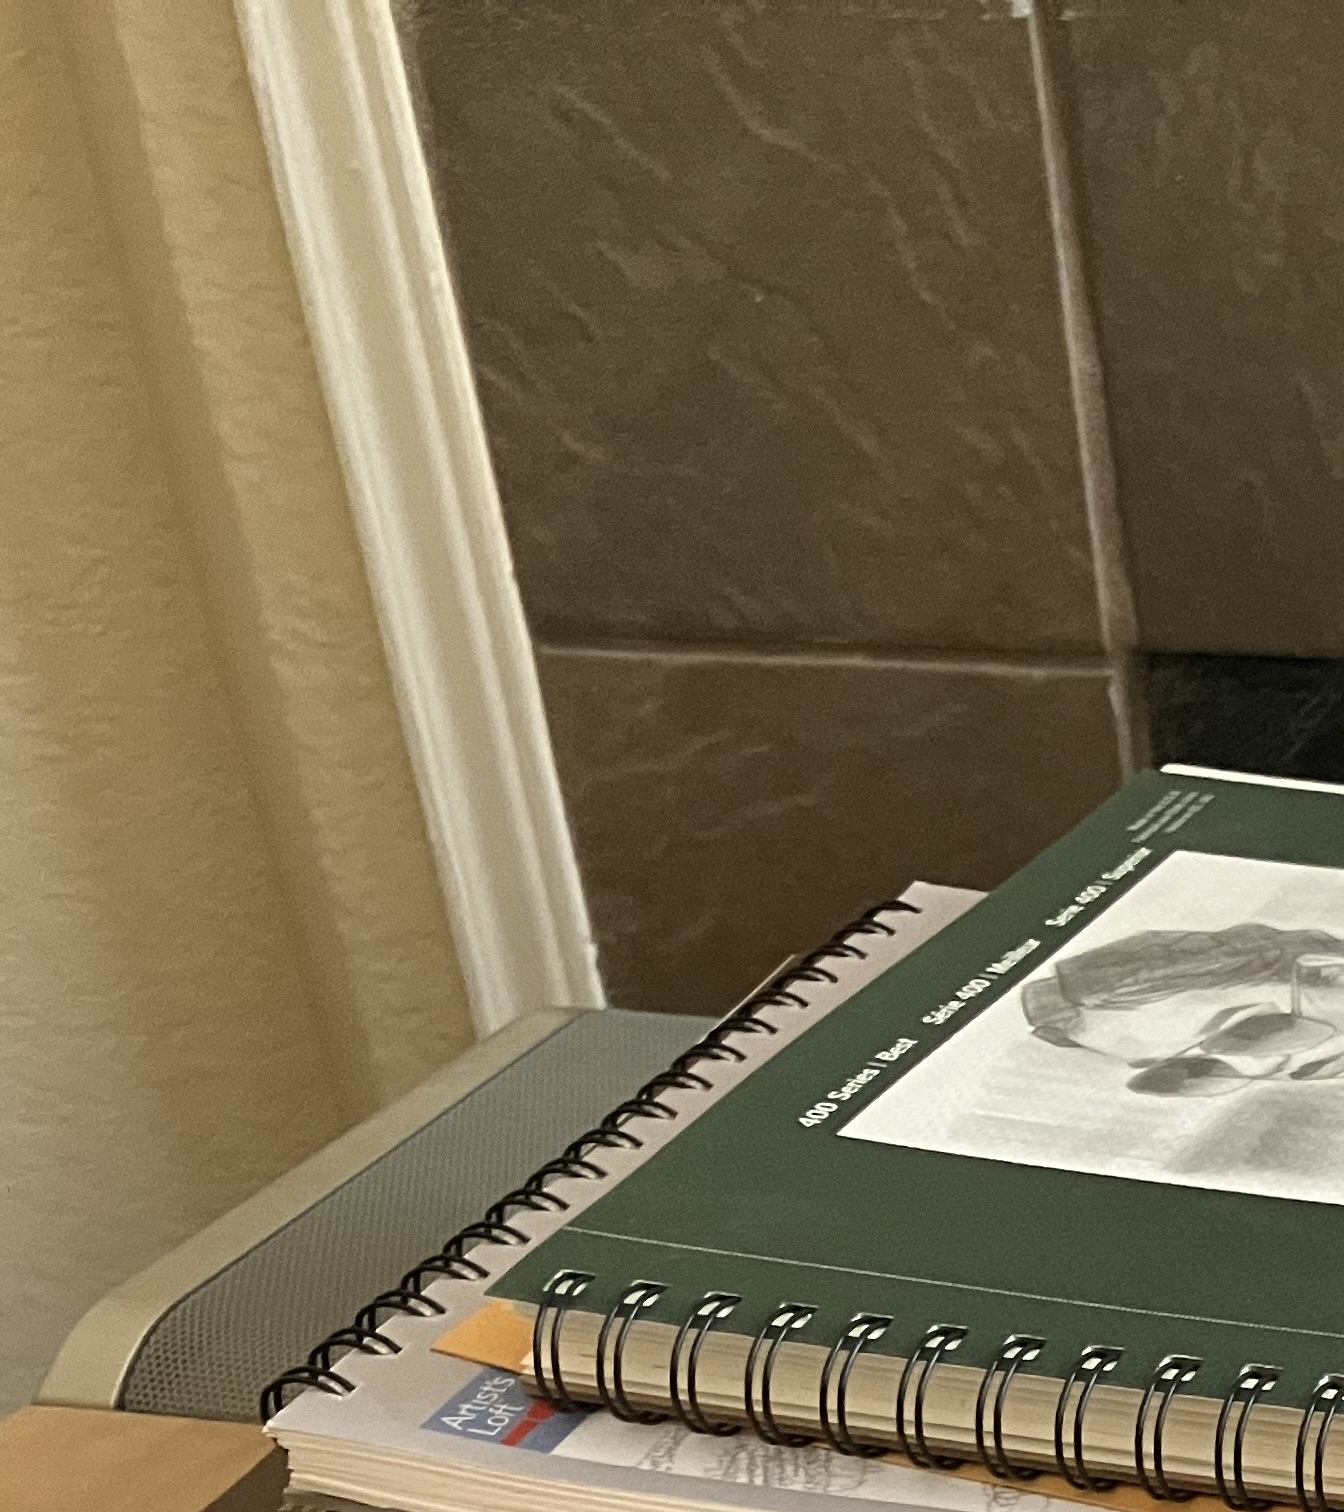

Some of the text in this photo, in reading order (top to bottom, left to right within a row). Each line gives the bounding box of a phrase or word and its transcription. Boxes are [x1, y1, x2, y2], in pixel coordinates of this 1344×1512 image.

[798, 1038, 918, 1128] 400 Series Best
[468, 1403, 525, 1436] Loft
